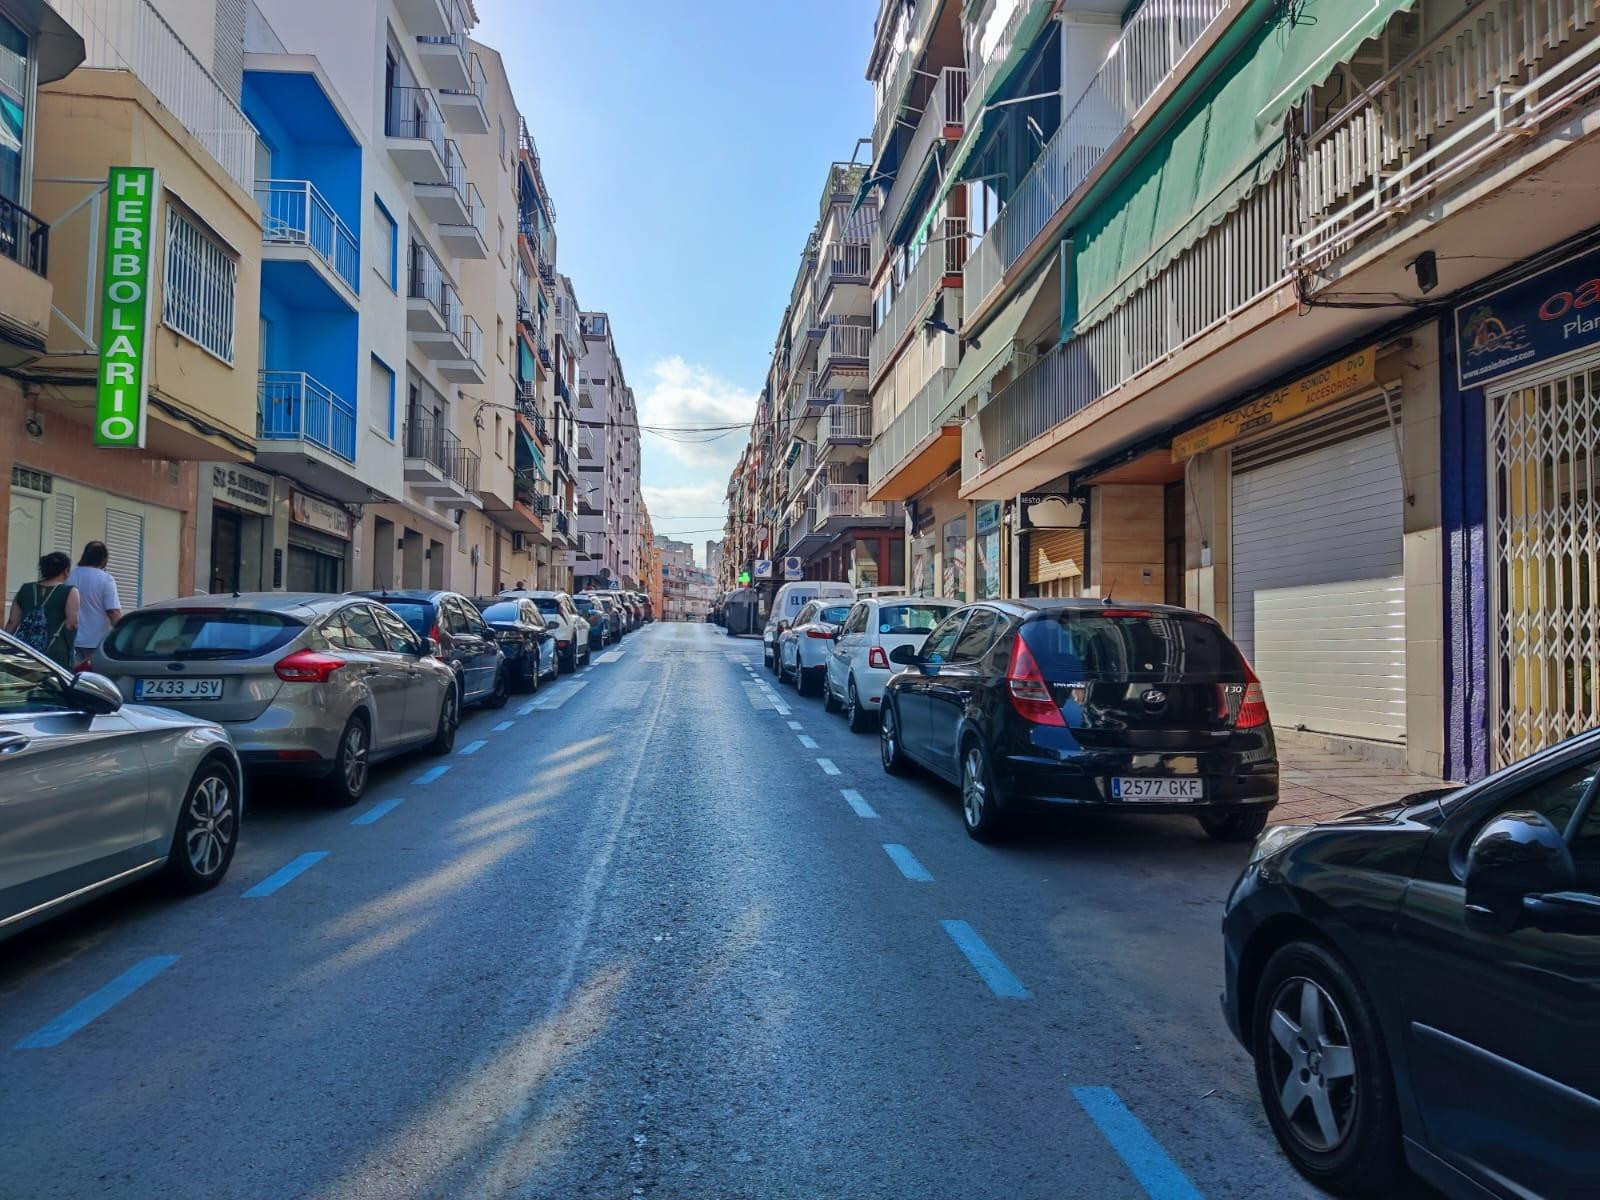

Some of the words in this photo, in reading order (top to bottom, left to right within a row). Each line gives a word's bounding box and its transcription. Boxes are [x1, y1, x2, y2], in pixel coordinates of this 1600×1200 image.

[101, 173, 147, 440] HERBOLARIO
[1300, 370, 1331, 392] SONIDO
[1346, 355, 1366, 371] DVD
[1305, 373, 1359, 405] ACCESORIOS
[1223, 387, 1290, 425] FONOGRAF
[790, 595, 800, 606] EL
[146, 681, 185, 694] 2433
[190, 681, 219, 694] JSV
[1123, 780, 1163, 795] 2577
[1169, 780, 1198, 795] GKF
